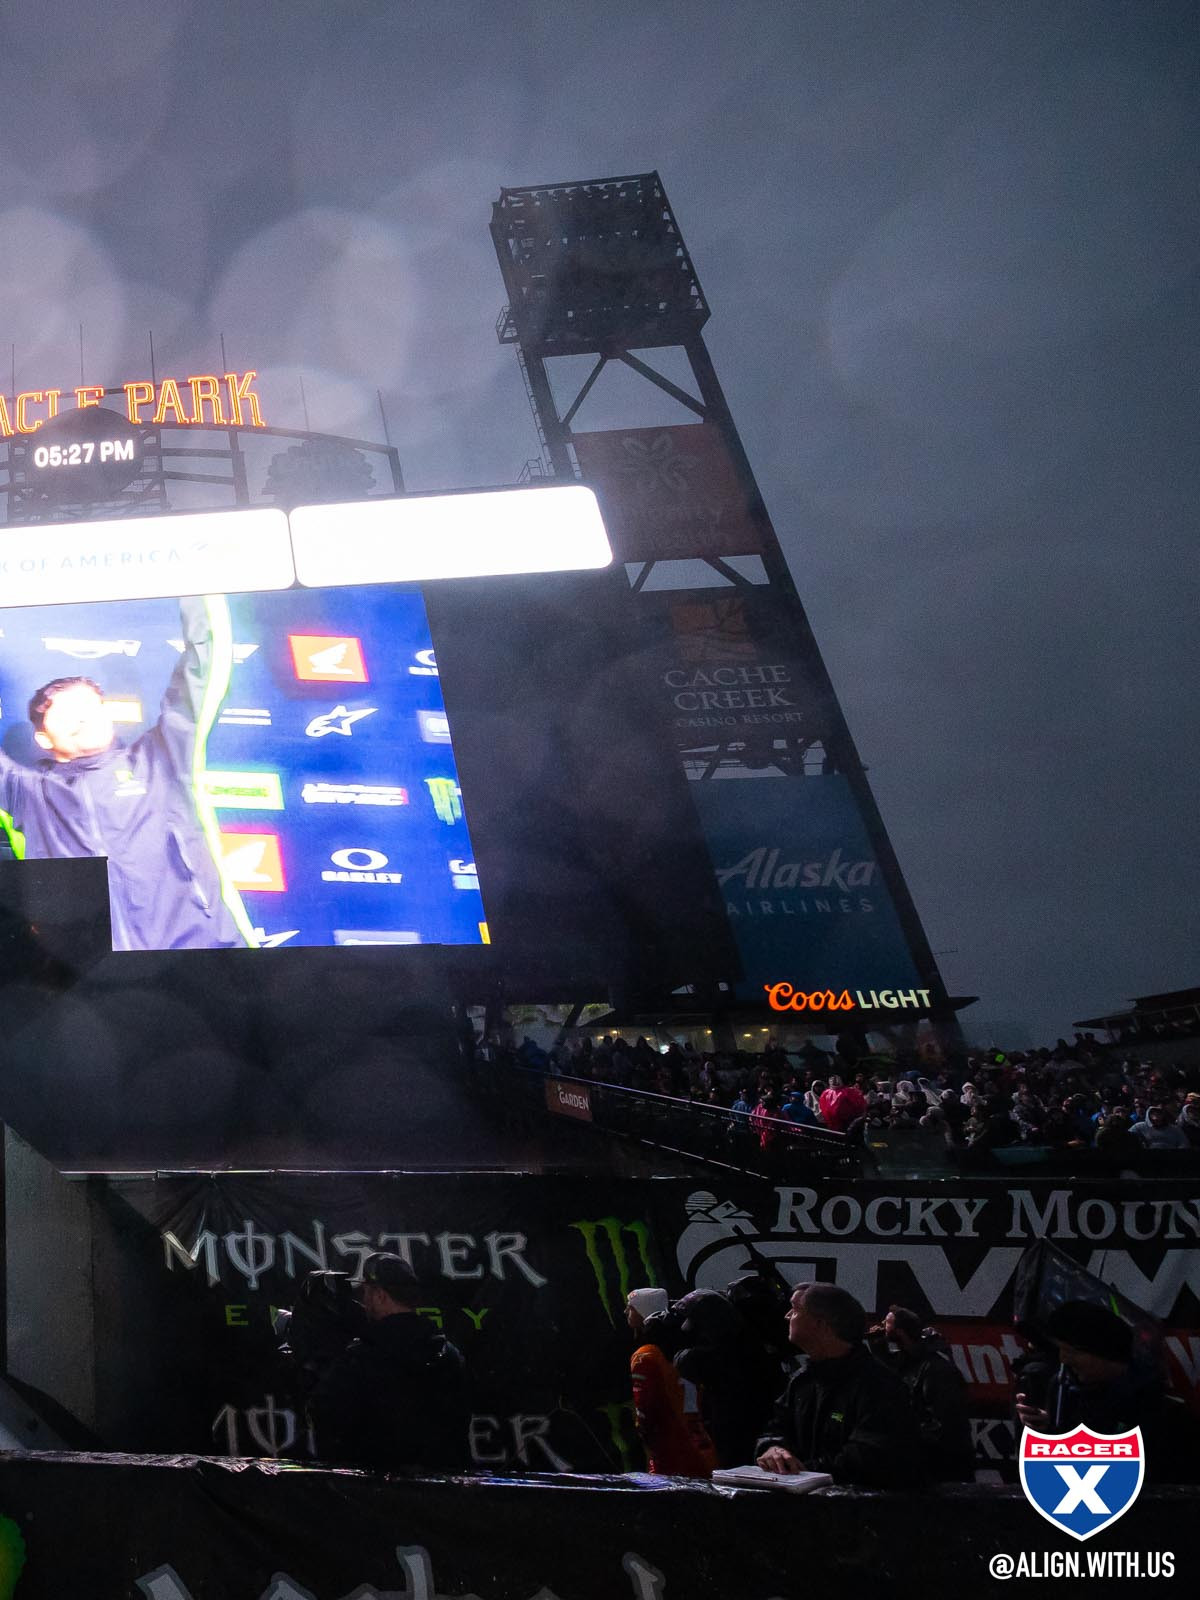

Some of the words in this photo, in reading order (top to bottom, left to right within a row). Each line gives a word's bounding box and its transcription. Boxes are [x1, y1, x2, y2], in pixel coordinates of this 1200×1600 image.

[123, 371, 267, 428] PARK
[34, 442, 95, 469] 05:27
[100, 439, 135, 464] PM
[59, 548, 182, 570] AMERICA
[663, 665, 792, 689] CACHE
[674, 688, 798, 711] CREEK
[743, 711, 804, 725] RESORT
[715, 846, 876, 890] Alaska
[725, 898, 875, 916] AIRLINES
[763, 981, 856, 1012] Coors
[856, 988, 932, 1010] LIGHT
[559, 1091, 590, 1112] GARDEN
[770, 1186, 990, 1238] ROCKY
[160, 1220, 549, 1290] MONSTER
